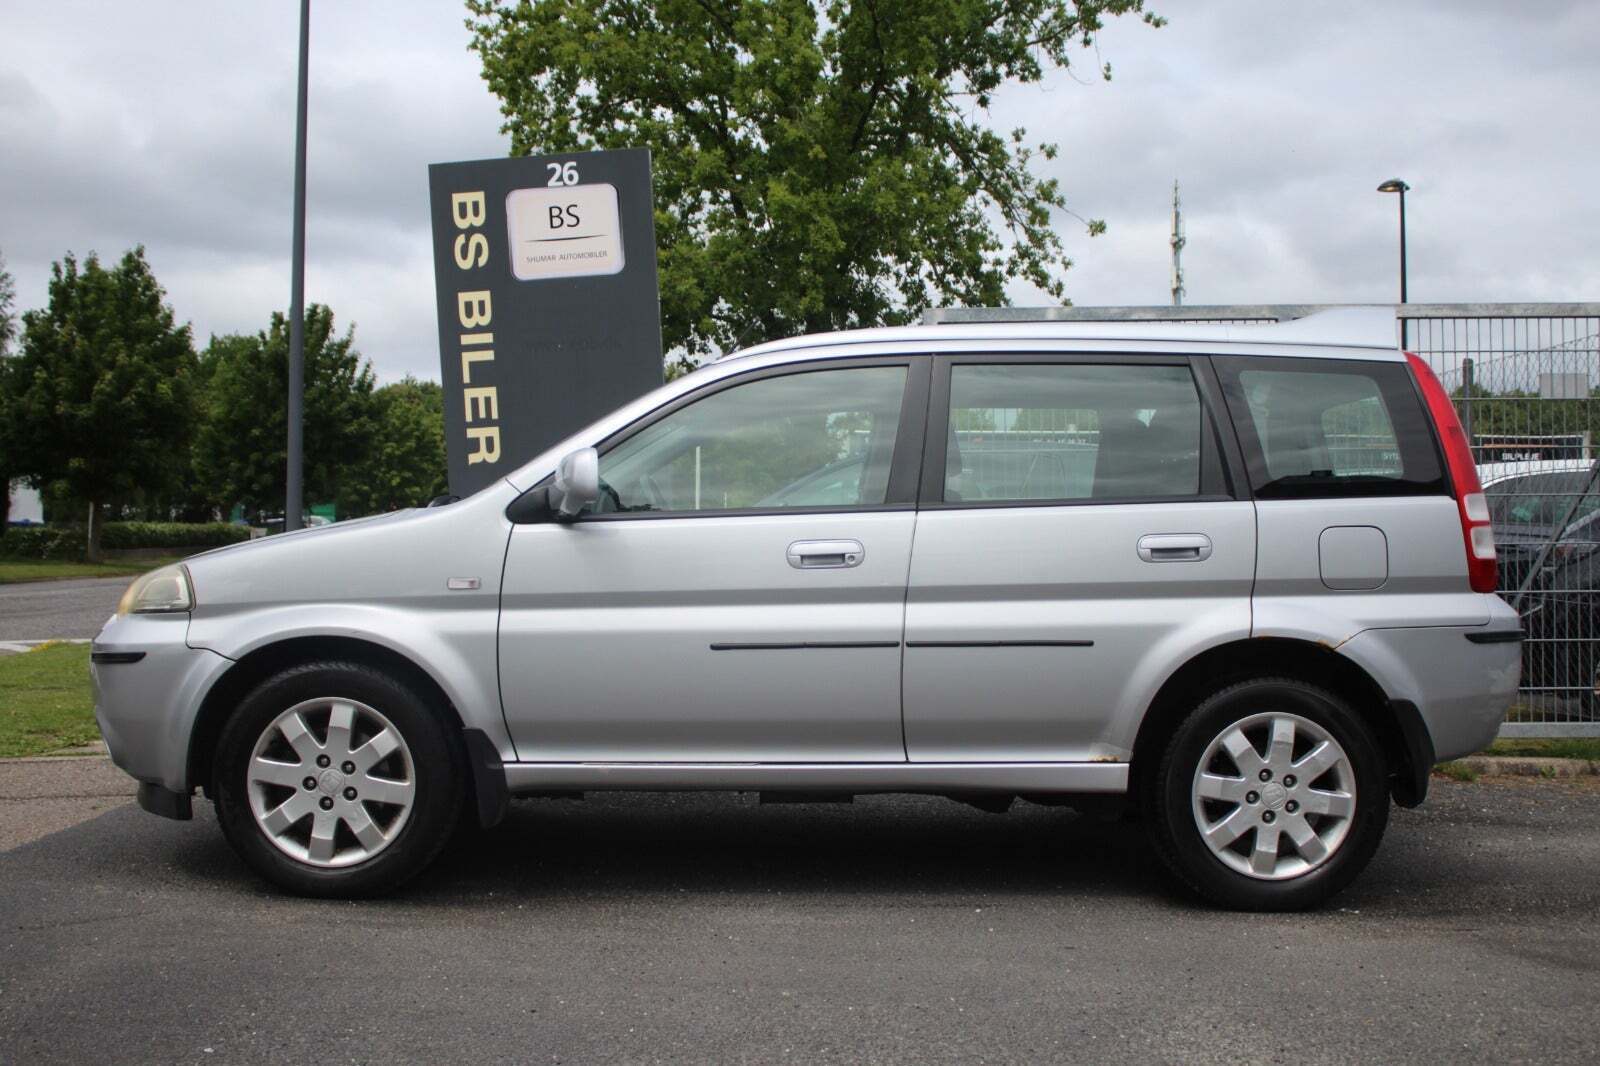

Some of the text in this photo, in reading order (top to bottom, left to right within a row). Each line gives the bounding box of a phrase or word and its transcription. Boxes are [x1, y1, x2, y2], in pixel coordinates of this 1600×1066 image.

[546, 161, 580, 187] 26
[548, 204, 581, 229] BS
[526, 250, 608, 263] SHUMAR AUTOMOBILER
[452, 191, 501, 466] BS BILER
